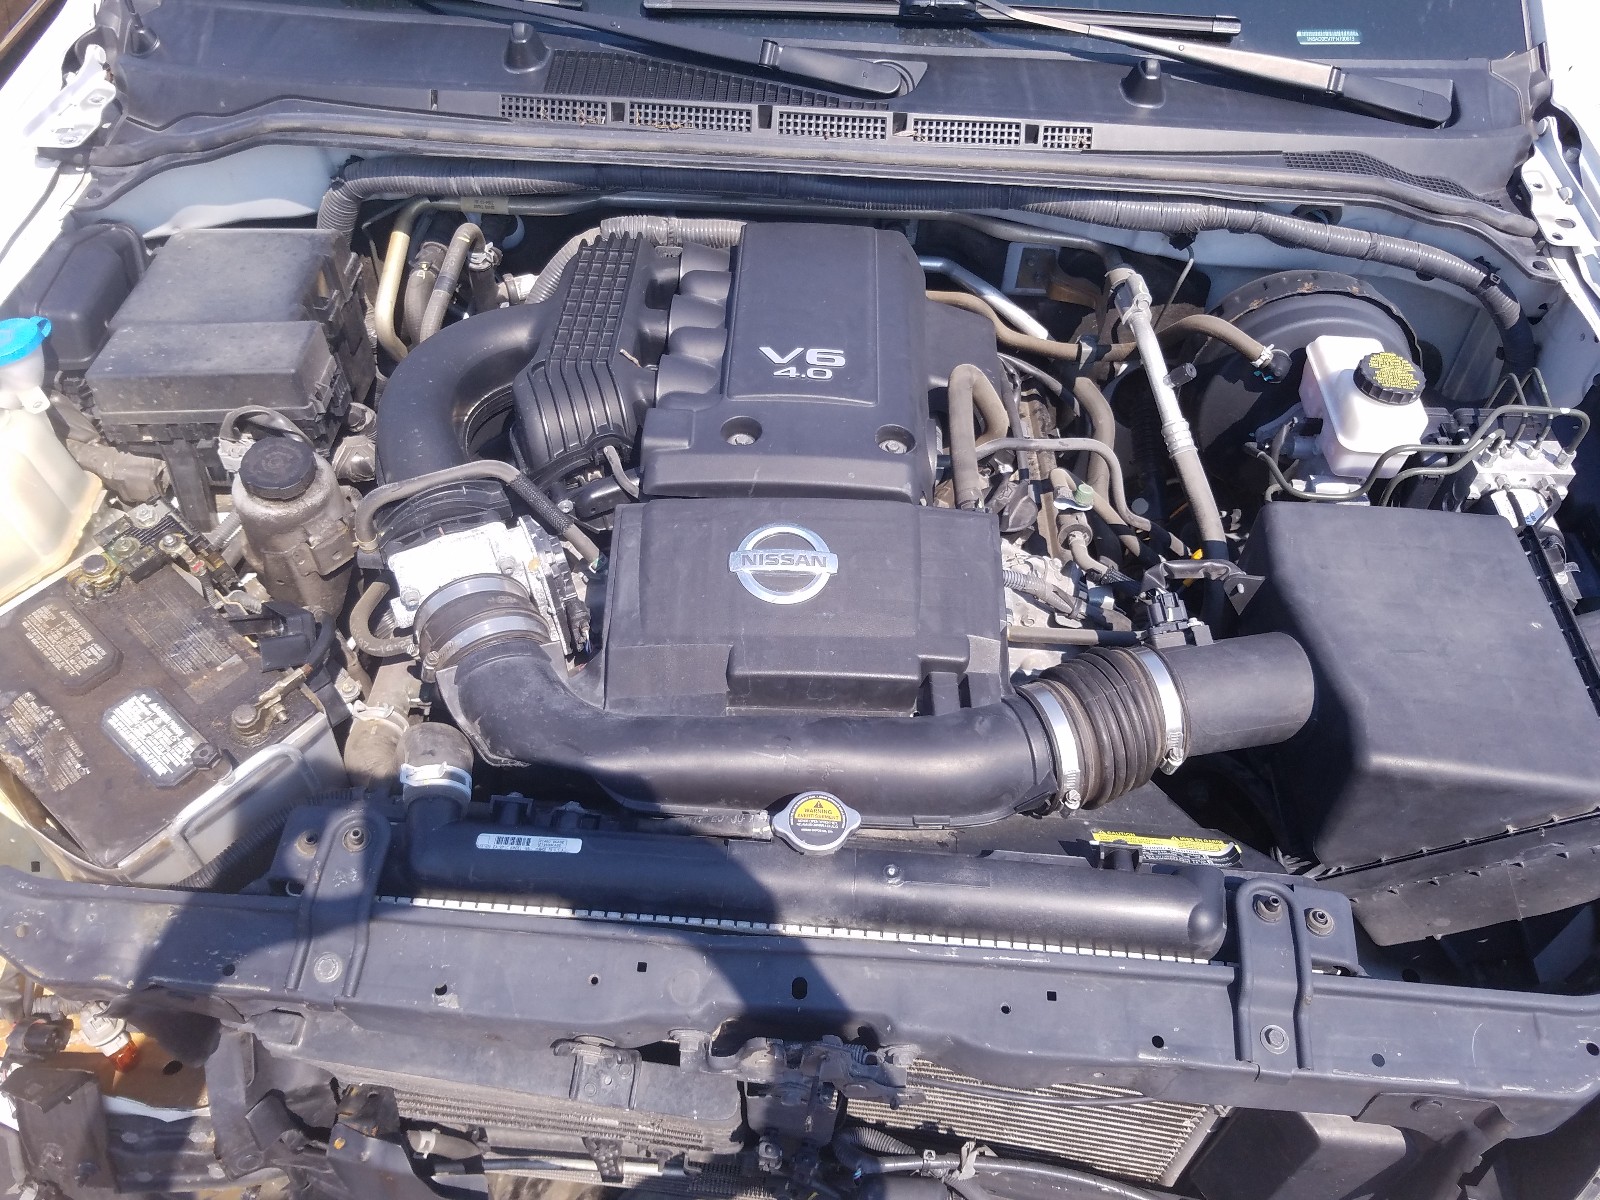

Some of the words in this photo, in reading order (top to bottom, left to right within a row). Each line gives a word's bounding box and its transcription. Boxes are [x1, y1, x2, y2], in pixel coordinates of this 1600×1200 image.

[759, 346, 846, 367] V6
[773, 366, 833, 380] 4.0
[741, 553, 827, 568] NISSAN
[804, 807, 833, 815] WARNING
